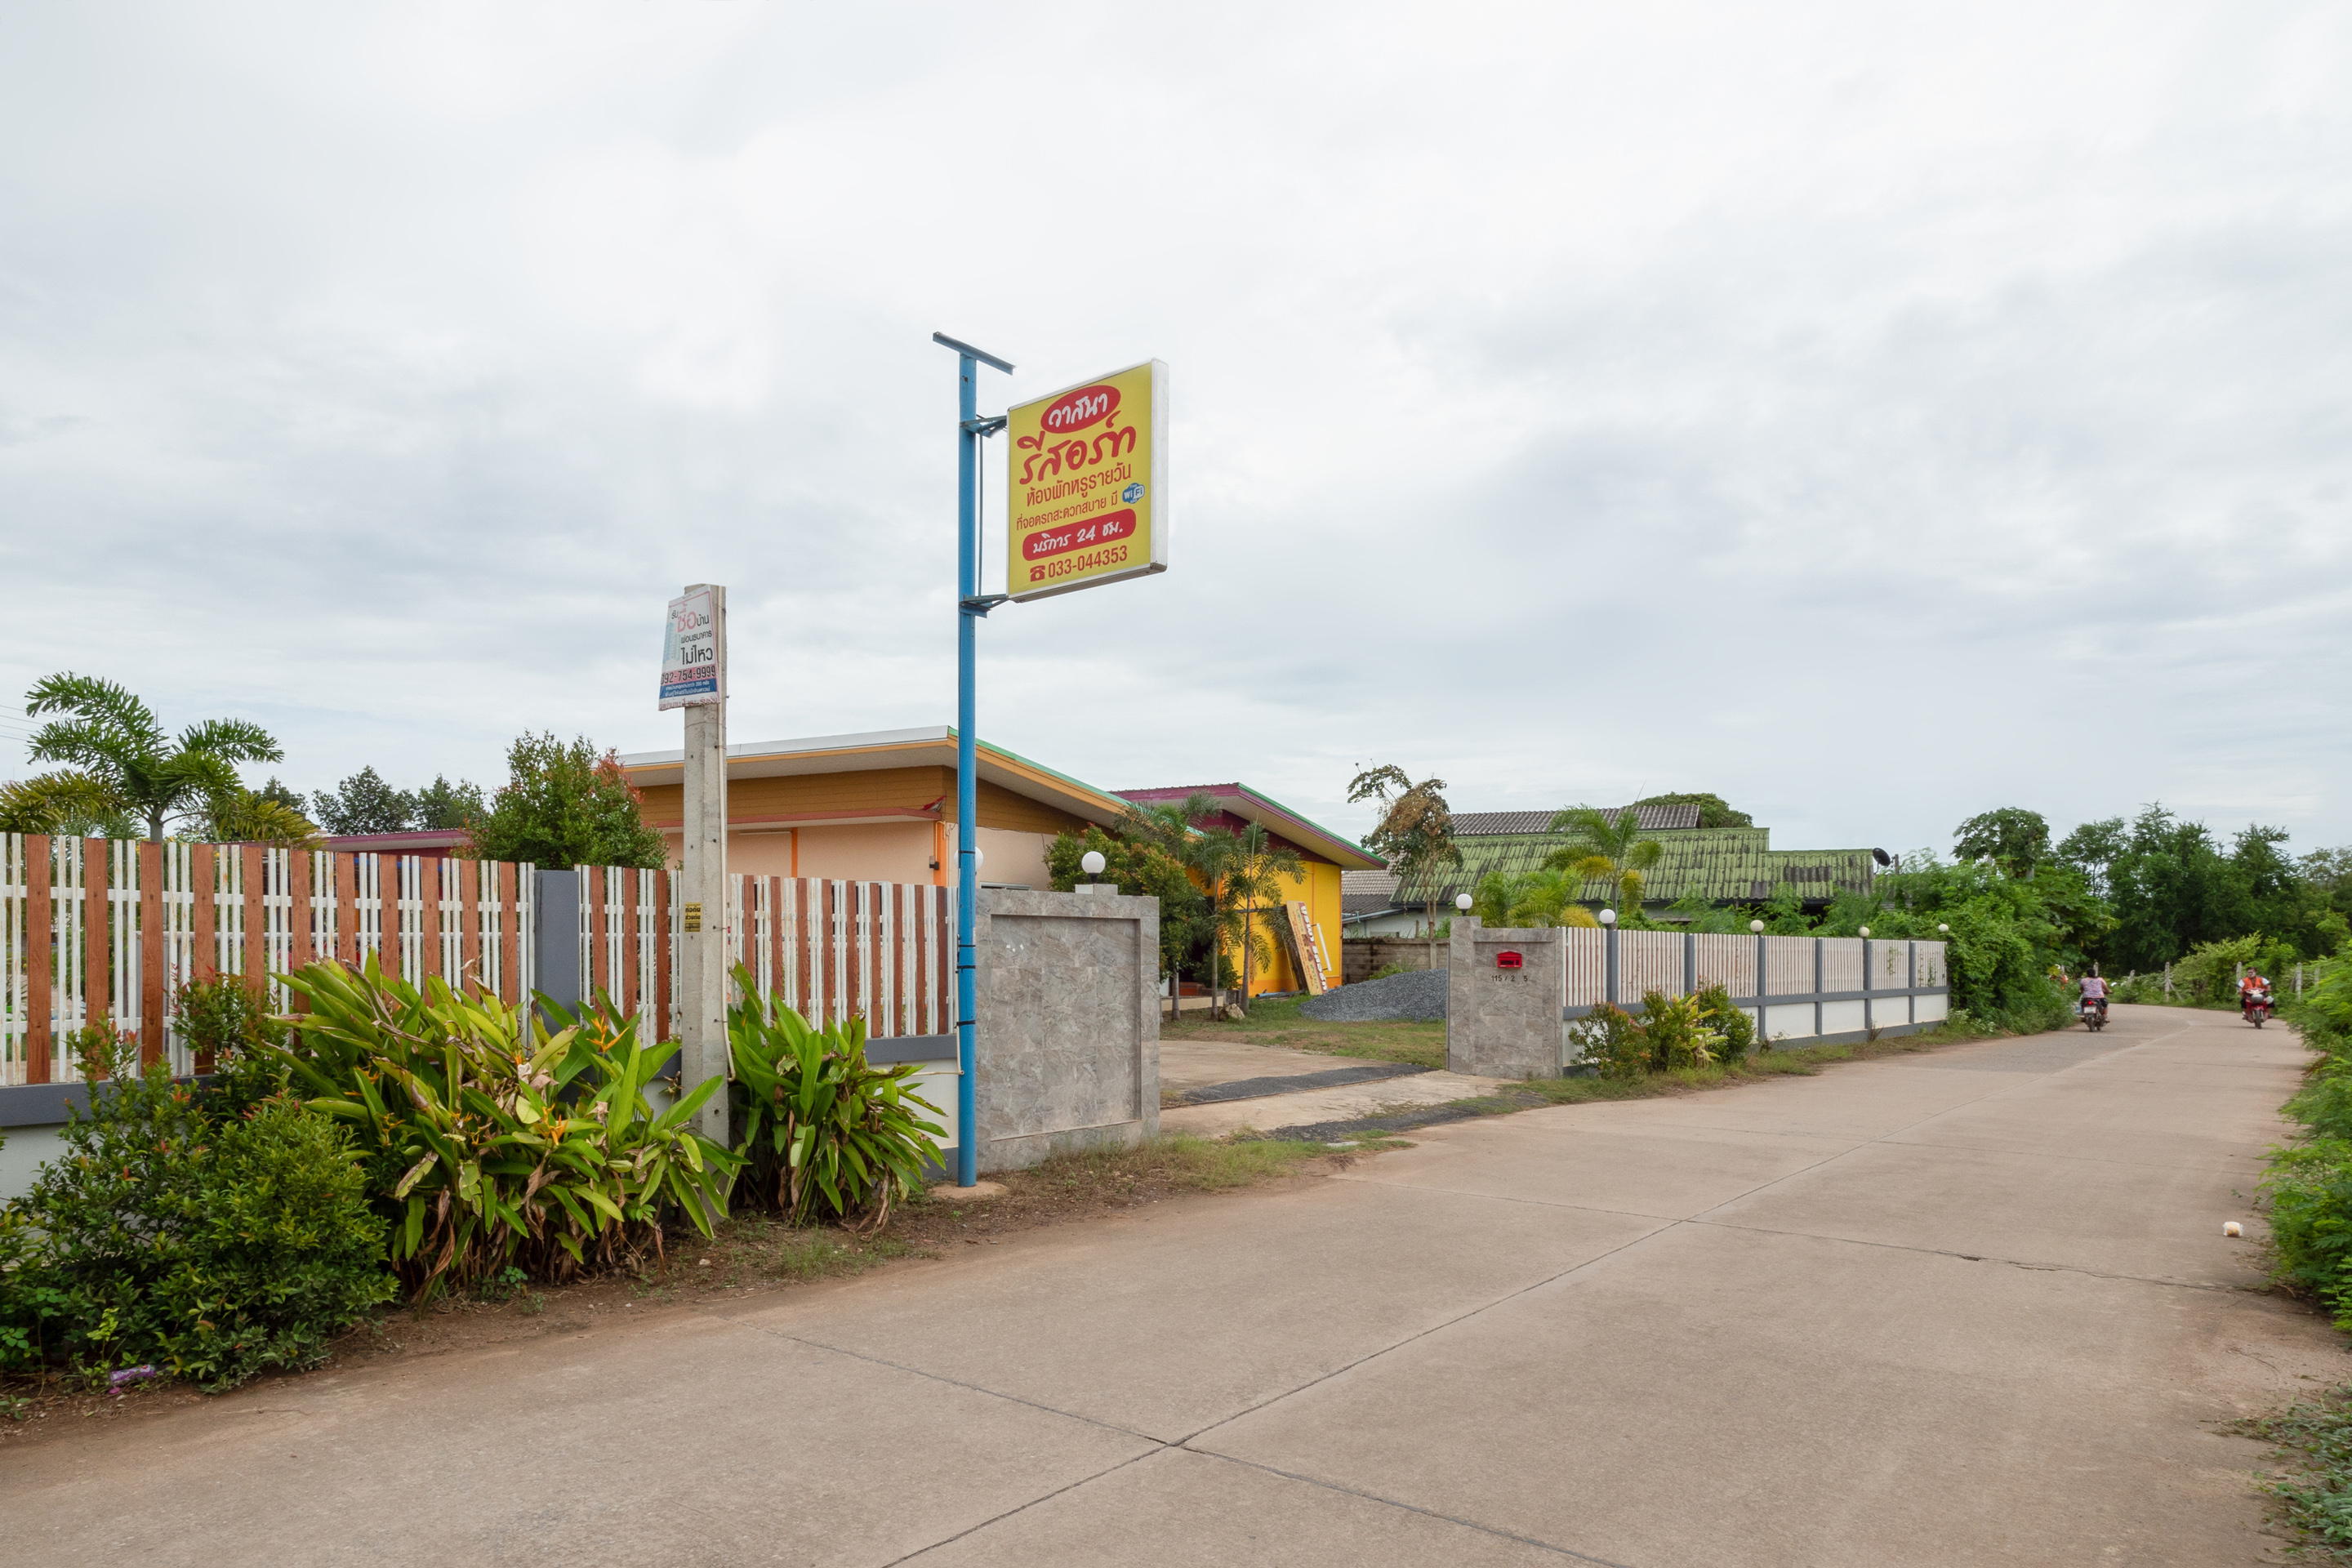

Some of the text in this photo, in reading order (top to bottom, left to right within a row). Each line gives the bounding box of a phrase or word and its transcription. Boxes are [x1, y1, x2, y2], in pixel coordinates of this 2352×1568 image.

[1048, 393, 1108, 427] วาสนา
[1017, 410, 1137, 485] รีสอร์ท
[1027, 462, 1131, 507] ห้องพักหรูรายวัน
[1017, 490, 1118, 531] ที่จอดรถสะดวกสบาย มี
[1032, 532, 1071, 554] บริการ
[1076, 525, 1096, 543] 24
[1048, 545, 1128, 578] 033-044353
[680, 644, 713, 665] ไม่ไหว
